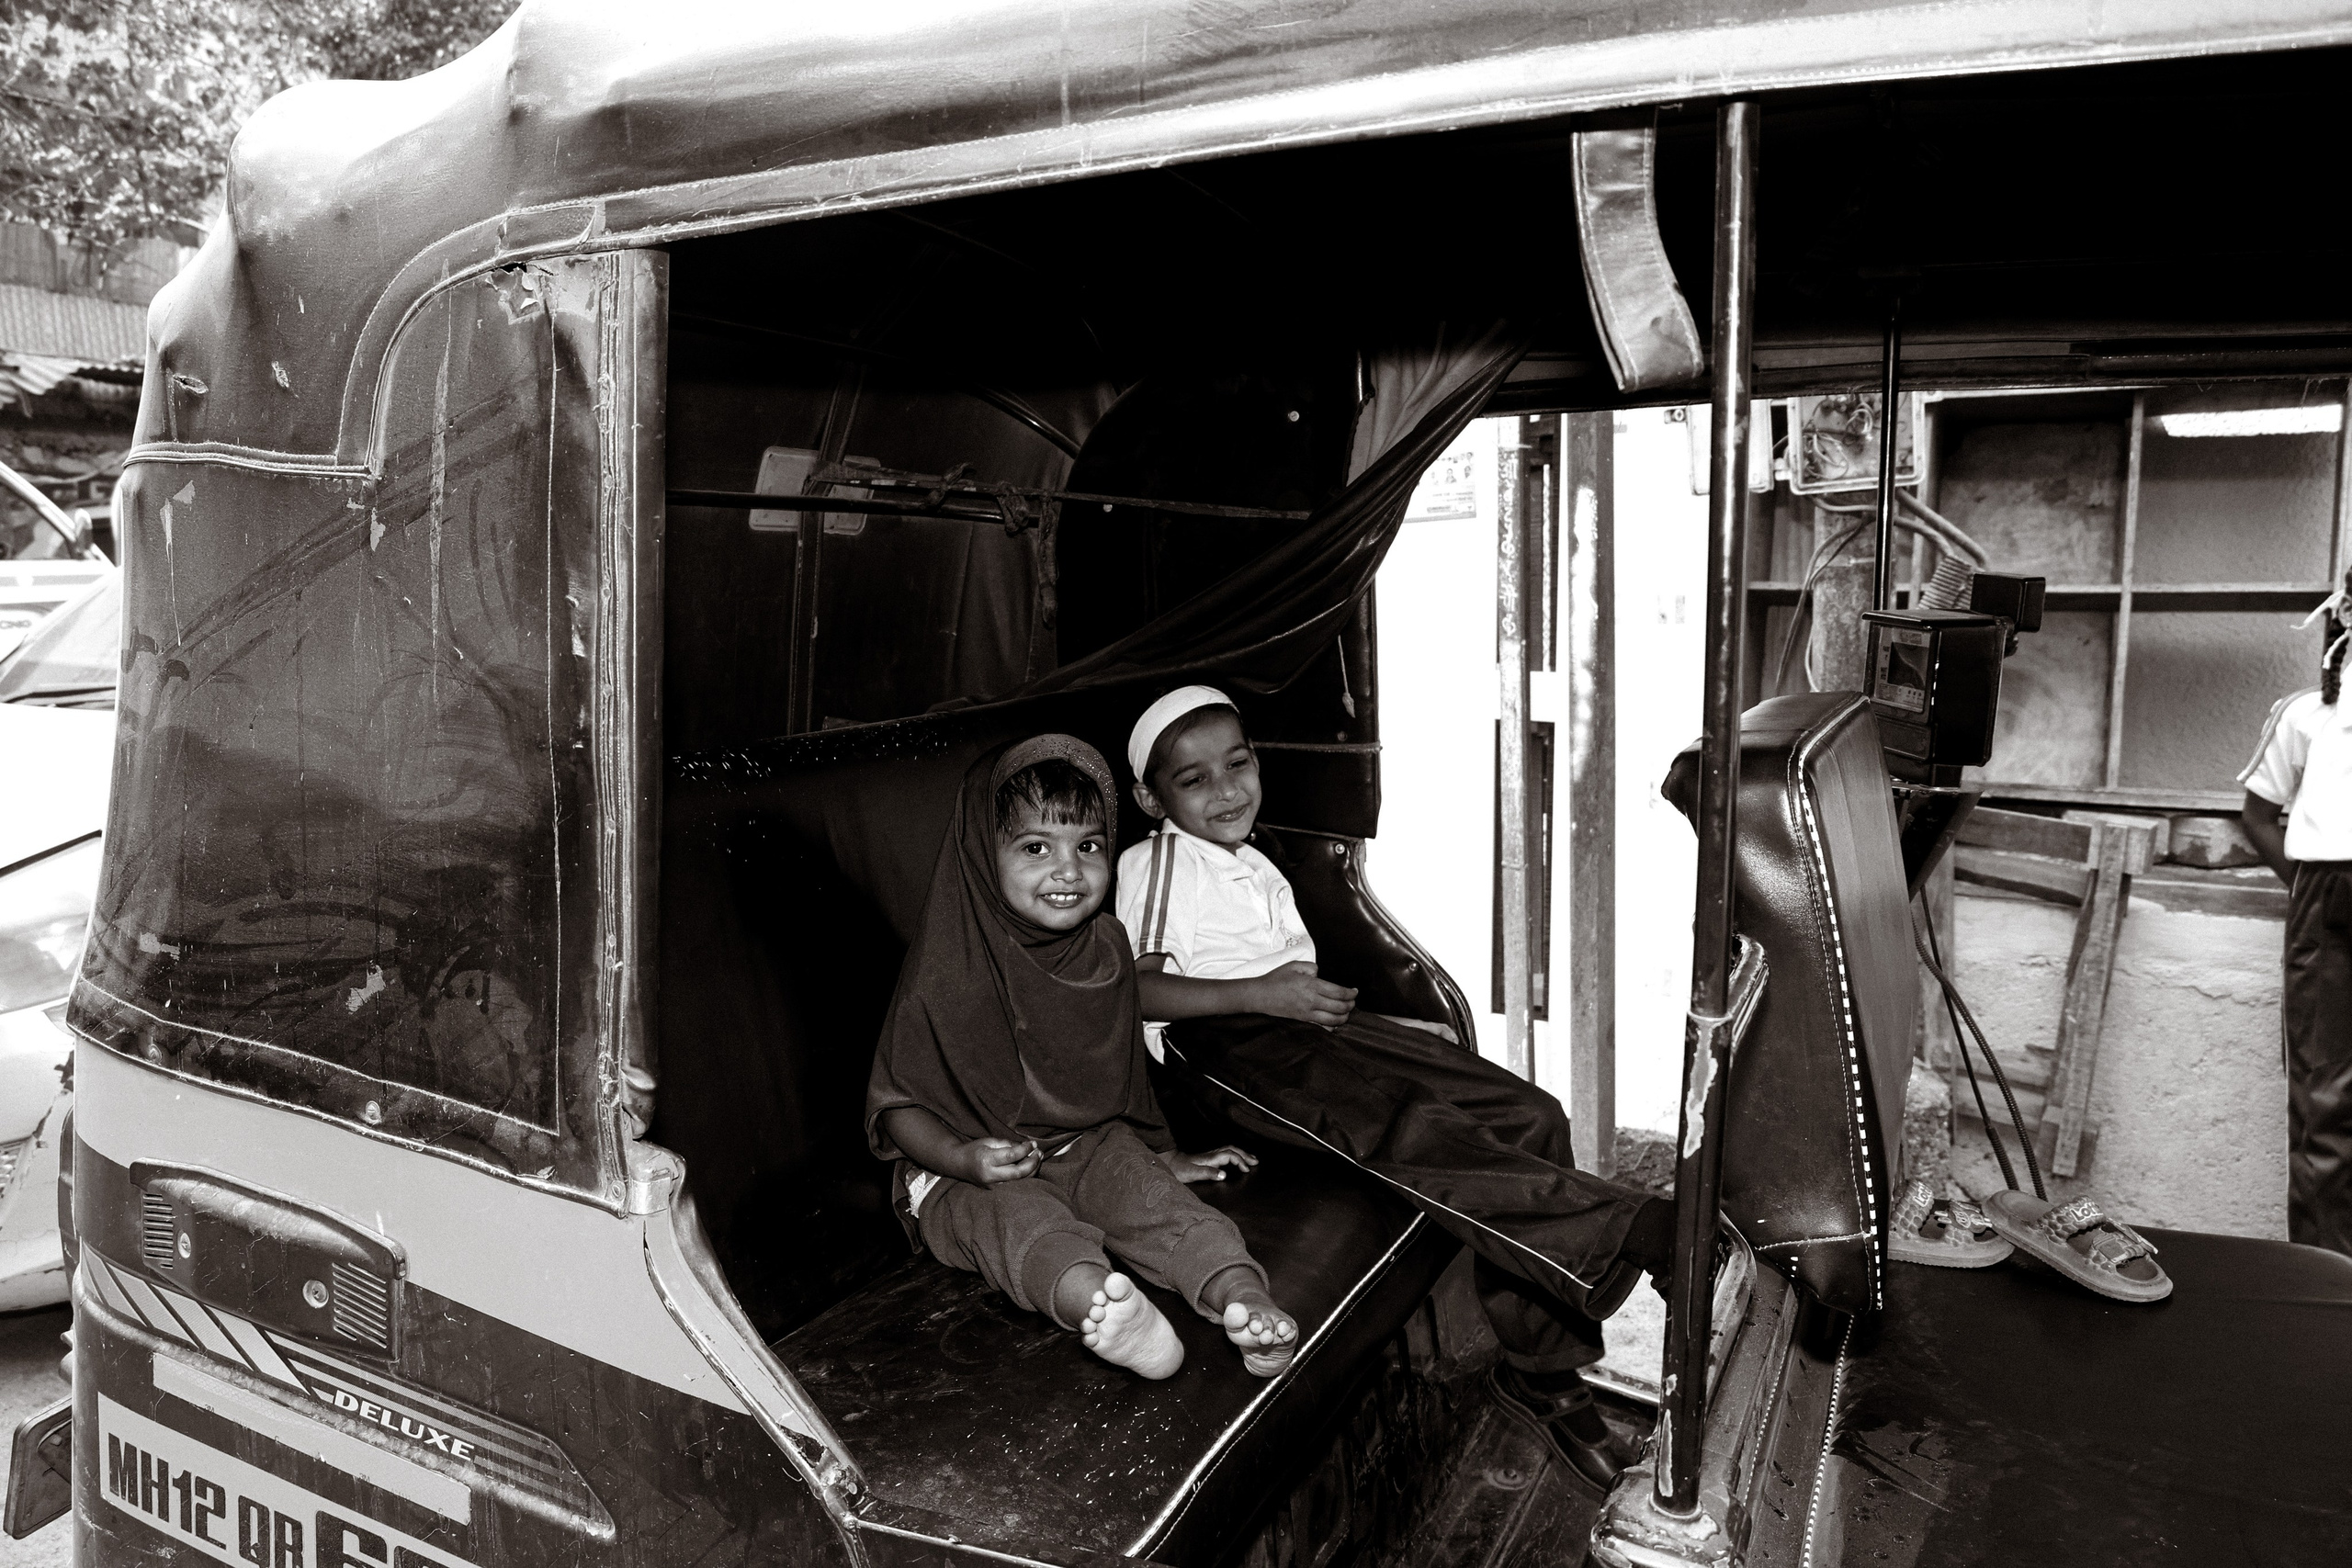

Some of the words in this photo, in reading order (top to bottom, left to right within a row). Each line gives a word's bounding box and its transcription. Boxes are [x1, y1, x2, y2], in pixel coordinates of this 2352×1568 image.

[334, 1389, 475, 1461] DELUXE
[108, 1432, 227, 1551] MH12
[238, 1495, 304, 1568] QR
